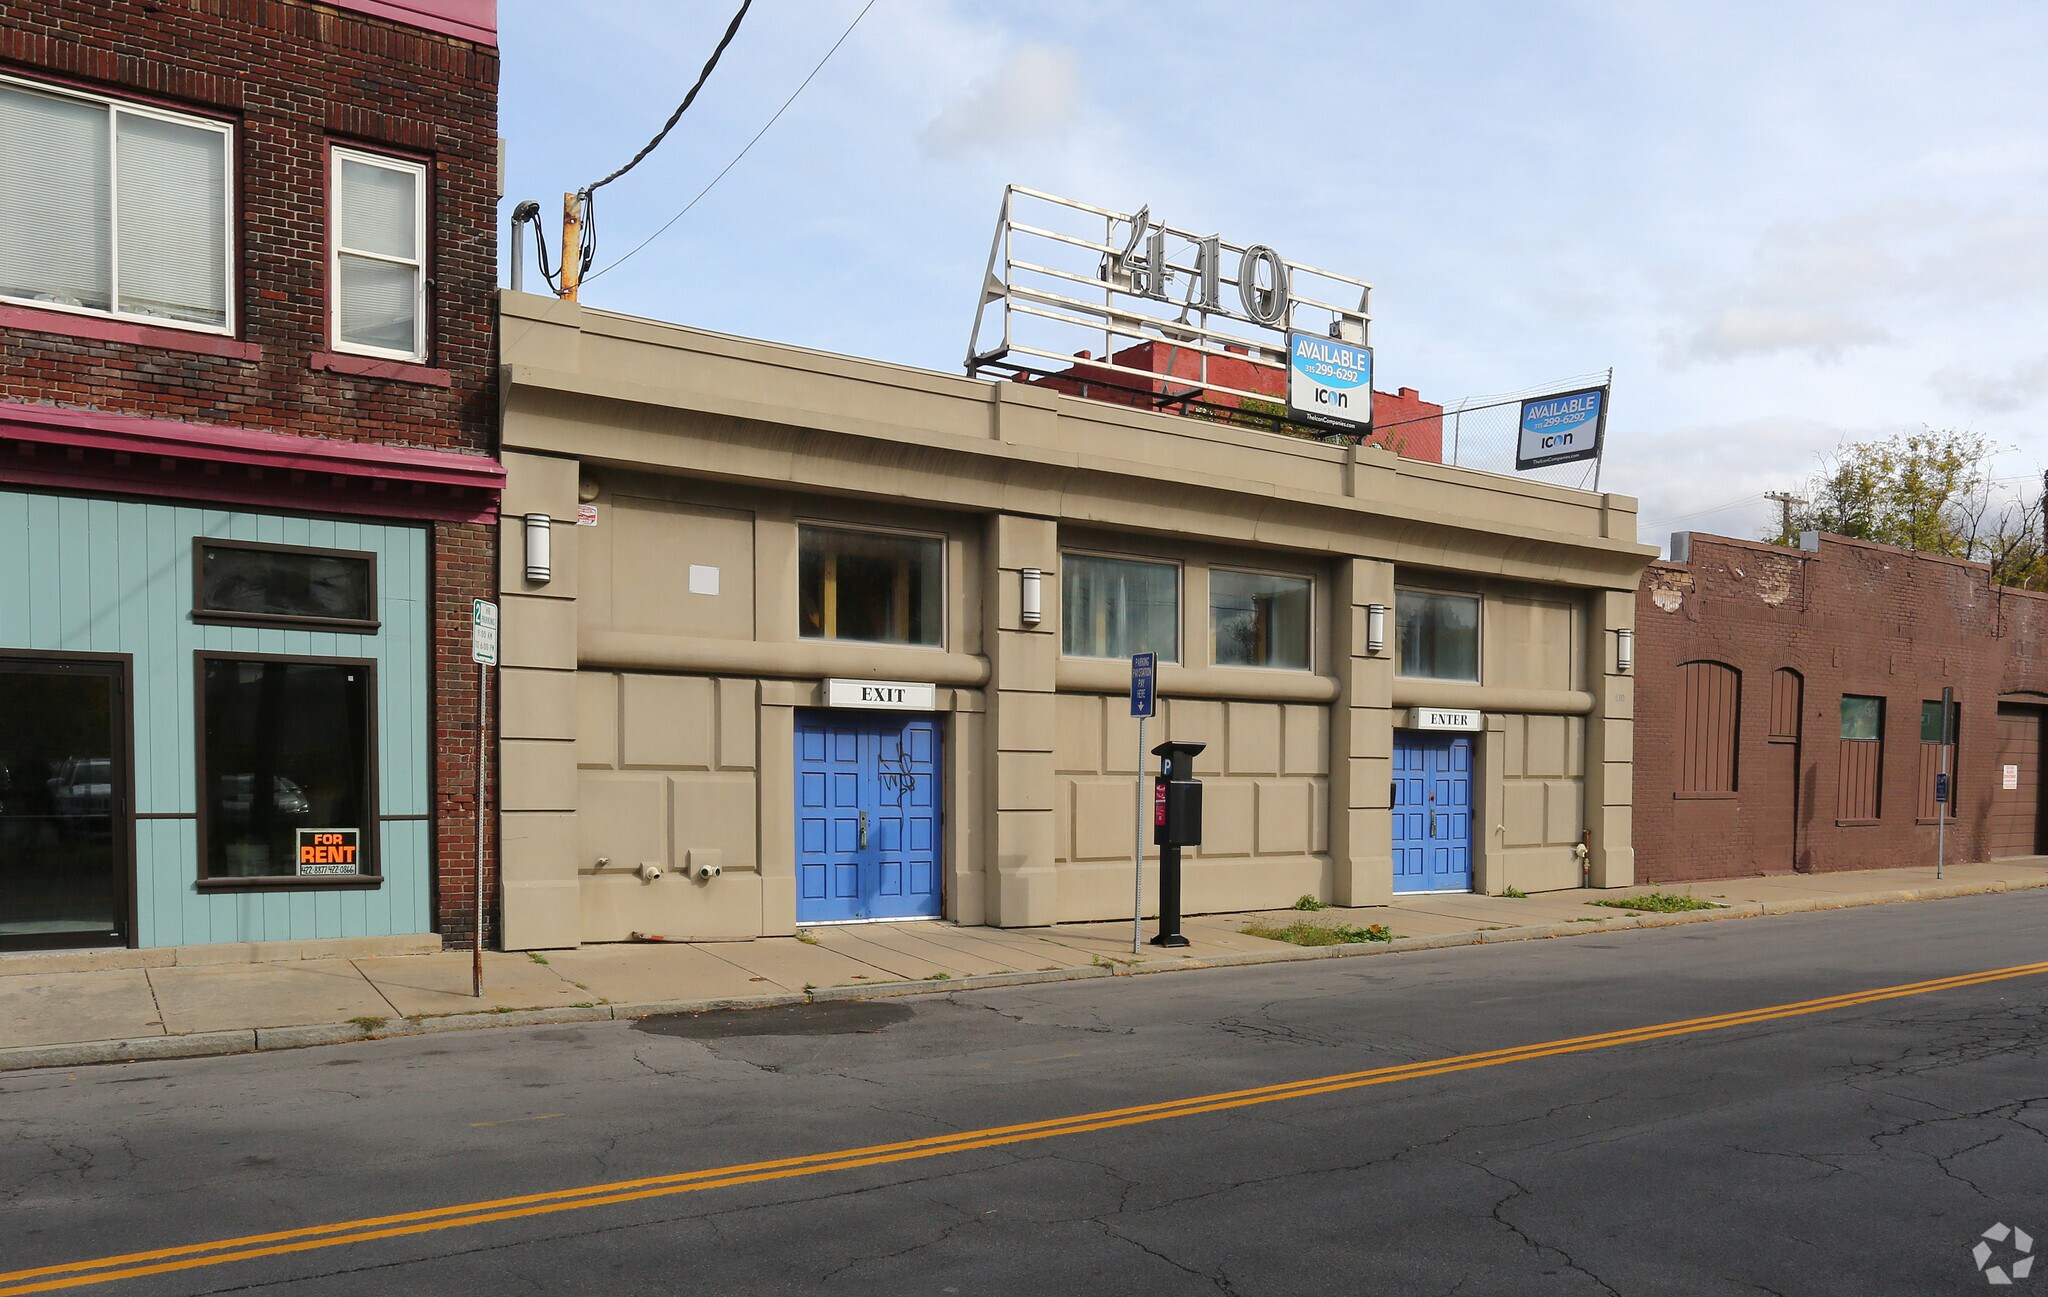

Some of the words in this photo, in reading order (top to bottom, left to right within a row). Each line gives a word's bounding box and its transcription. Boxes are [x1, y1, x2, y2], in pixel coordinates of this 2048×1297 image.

[1121, 203, 1288, 325] 410
[1296, 339, 1366, 372] AVAILABLE
[1305, 364, 1315, 373] 315
[1315, 362, 1358, 384] 299-6292
[1527, 396, 1595, 421] AVAILABLE
[1543, 412, 1586, 428] 299-6292
[475, 603, 481, 623] 2
[481, 615, 496, 626] PARKING
[487, 632, 493, 640] AM
[1135, 657, 1150, 667] PARKING
[861, 686, 906, 703] EXIT
[1430, 713, 1468, 726] ENTER
[1164, 758, 1172, 775] P
[314, 833, 343, 845] FOR
[301, 846, 356, 864] RENT
